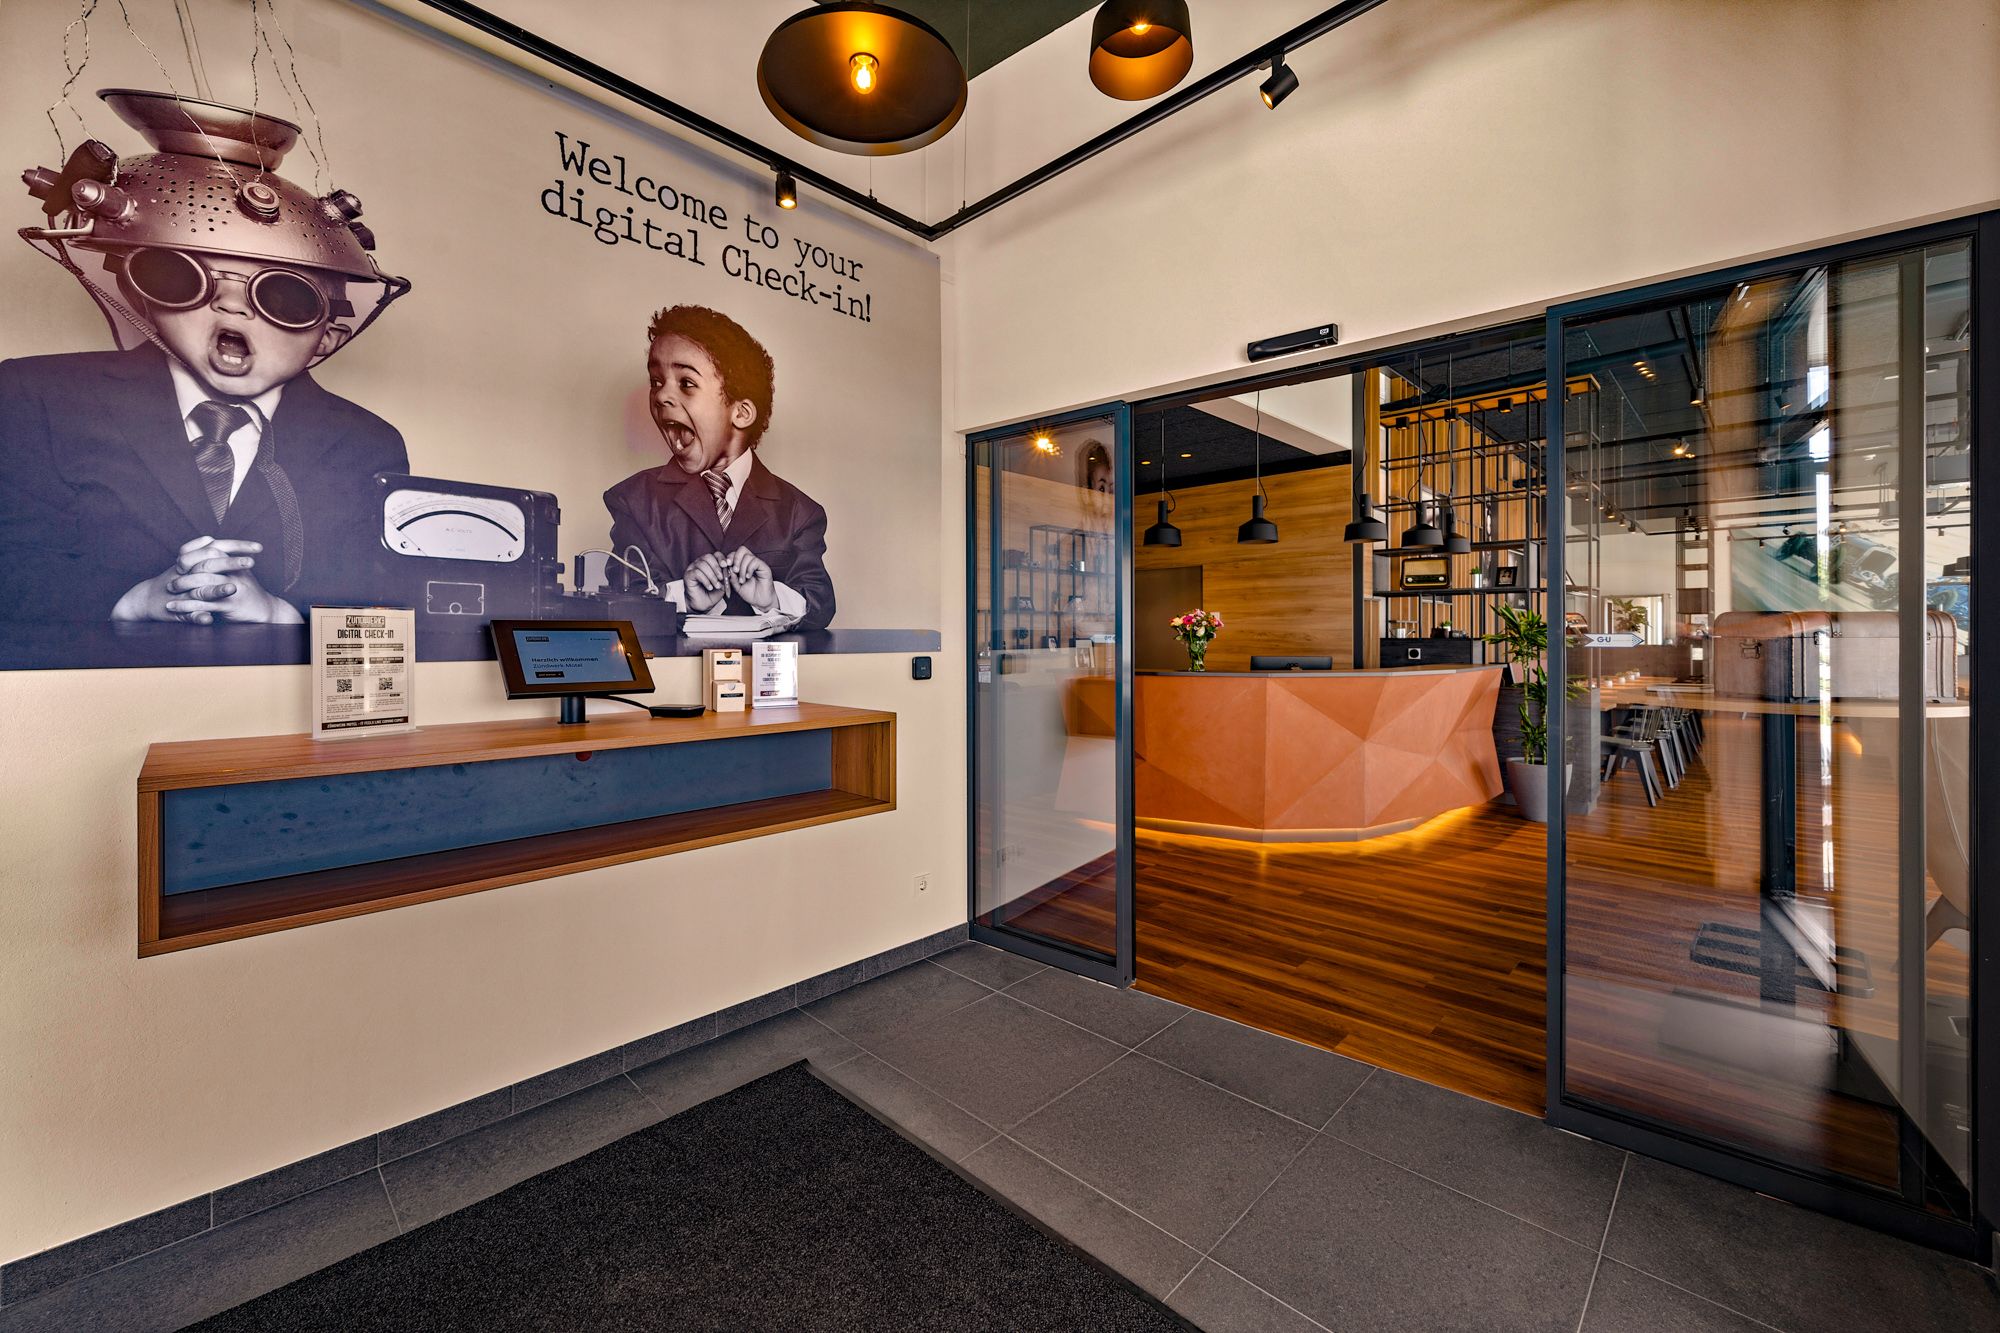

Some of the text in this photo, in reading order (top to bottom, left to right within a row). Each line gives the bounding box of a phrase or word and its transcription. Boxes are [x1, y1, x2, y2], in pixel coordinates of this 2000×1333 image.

[541, 179, 872, 323] digital Check-in!
[555, 130, 864, 283] Welcome to your
[337, 629, 394, 639] DIGITAL CHECK-IN
